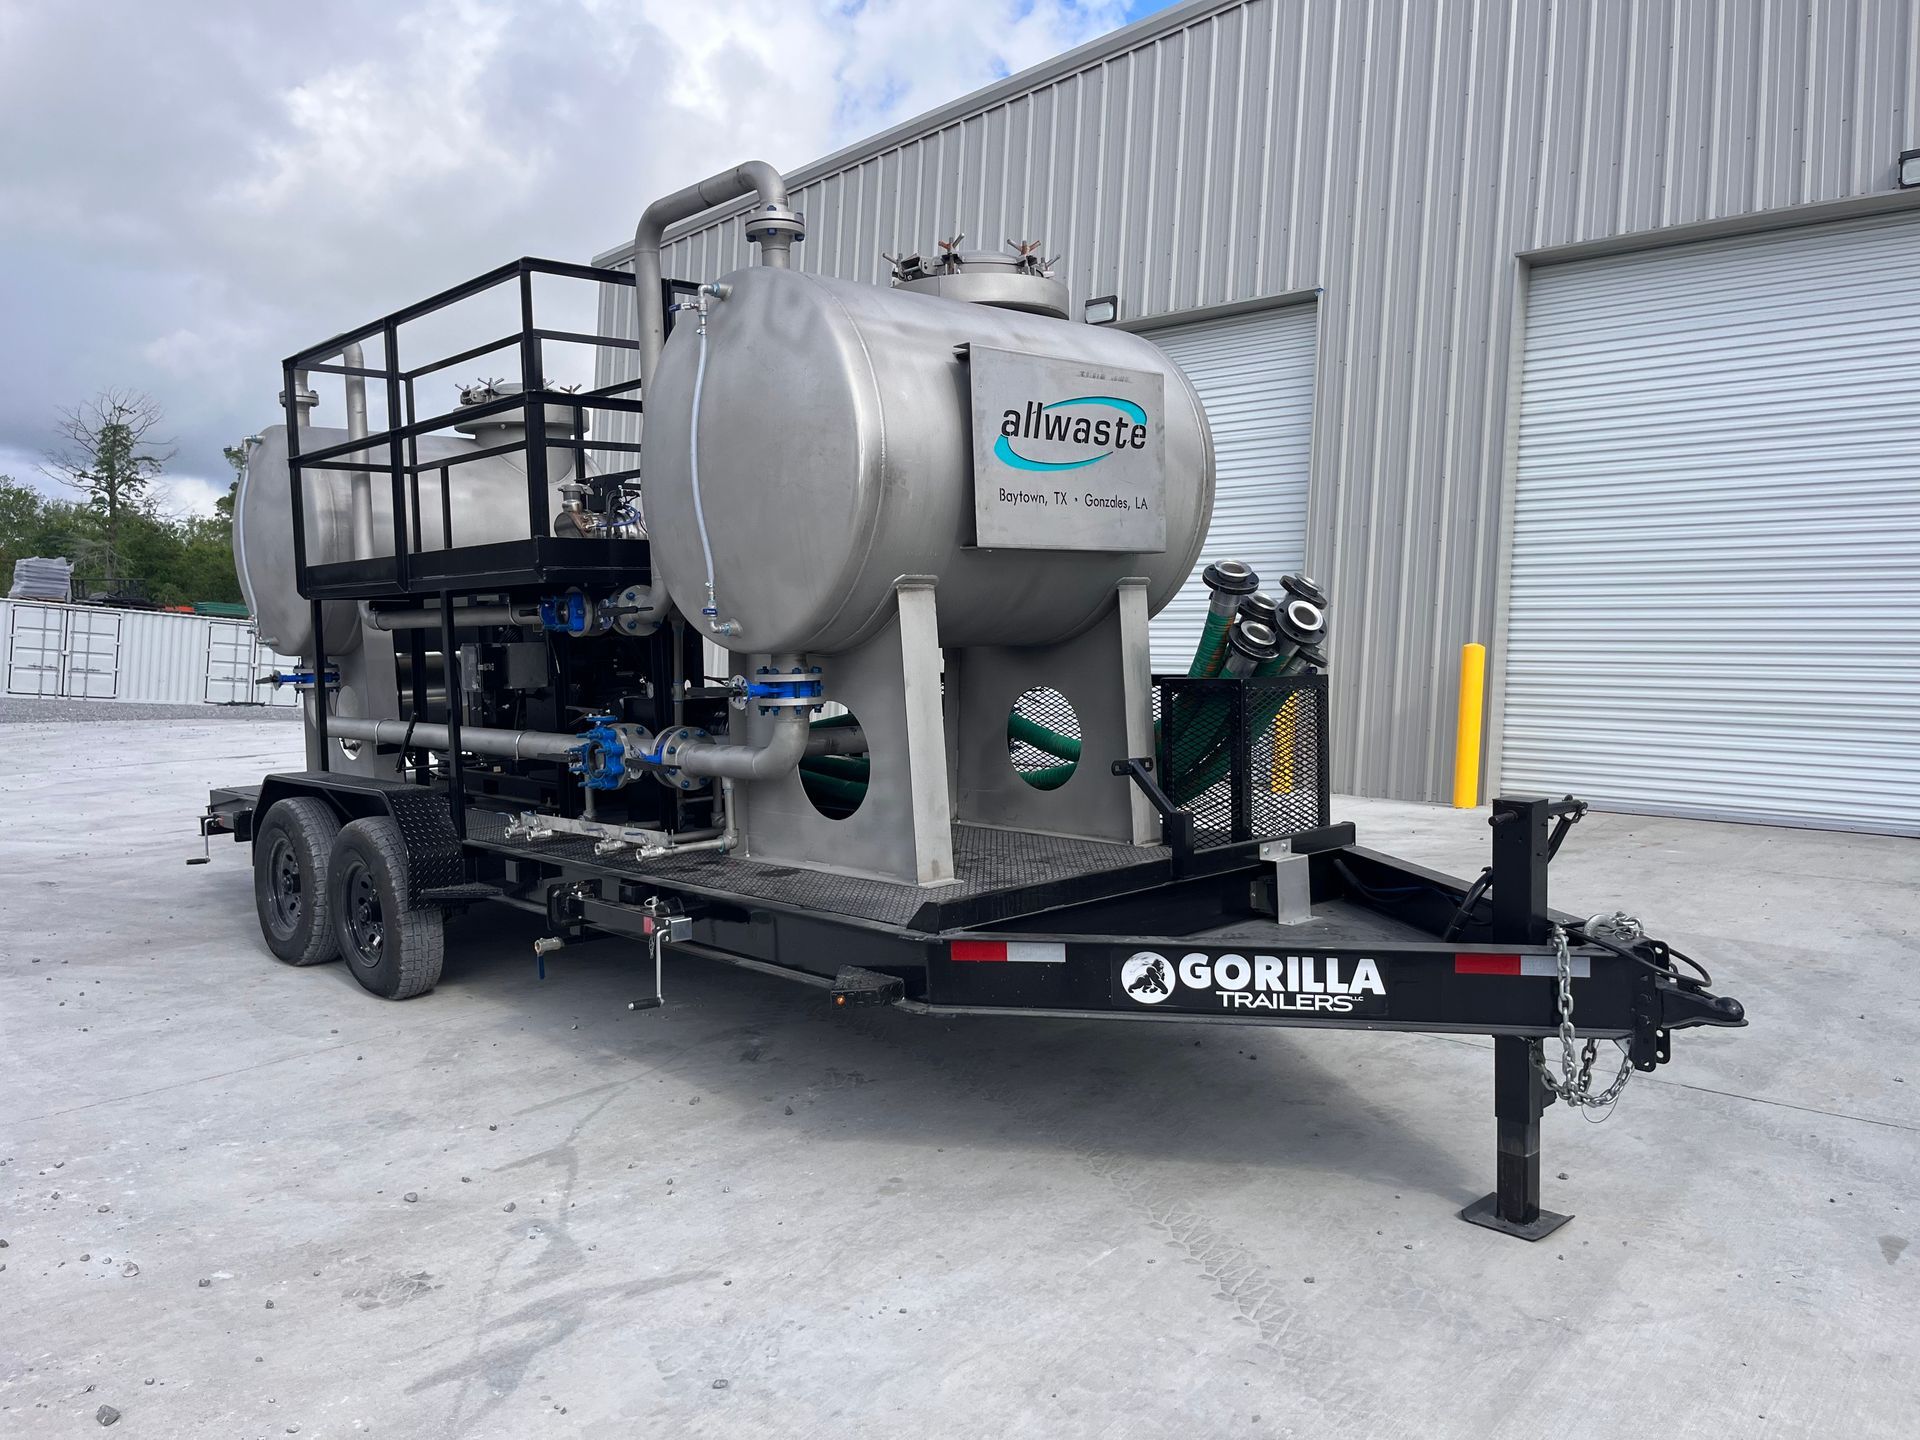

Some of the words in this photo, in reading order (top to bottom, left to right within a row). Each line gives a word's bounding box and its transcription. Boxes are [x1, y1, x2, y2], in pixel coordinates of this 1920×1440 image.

[1001, 401, 1147, 449] allwaste
[999, 488, 1048, 506] Baytown,
[1053, 491, 1068, 505] TX
[1084, 493, 1131, 511] Gonzales,
[1135, 497, 1149, 510] LA
[1178, 952, 1386, 995] GORILLA
[1215, 990, 1353, 1012] TRAILERS
